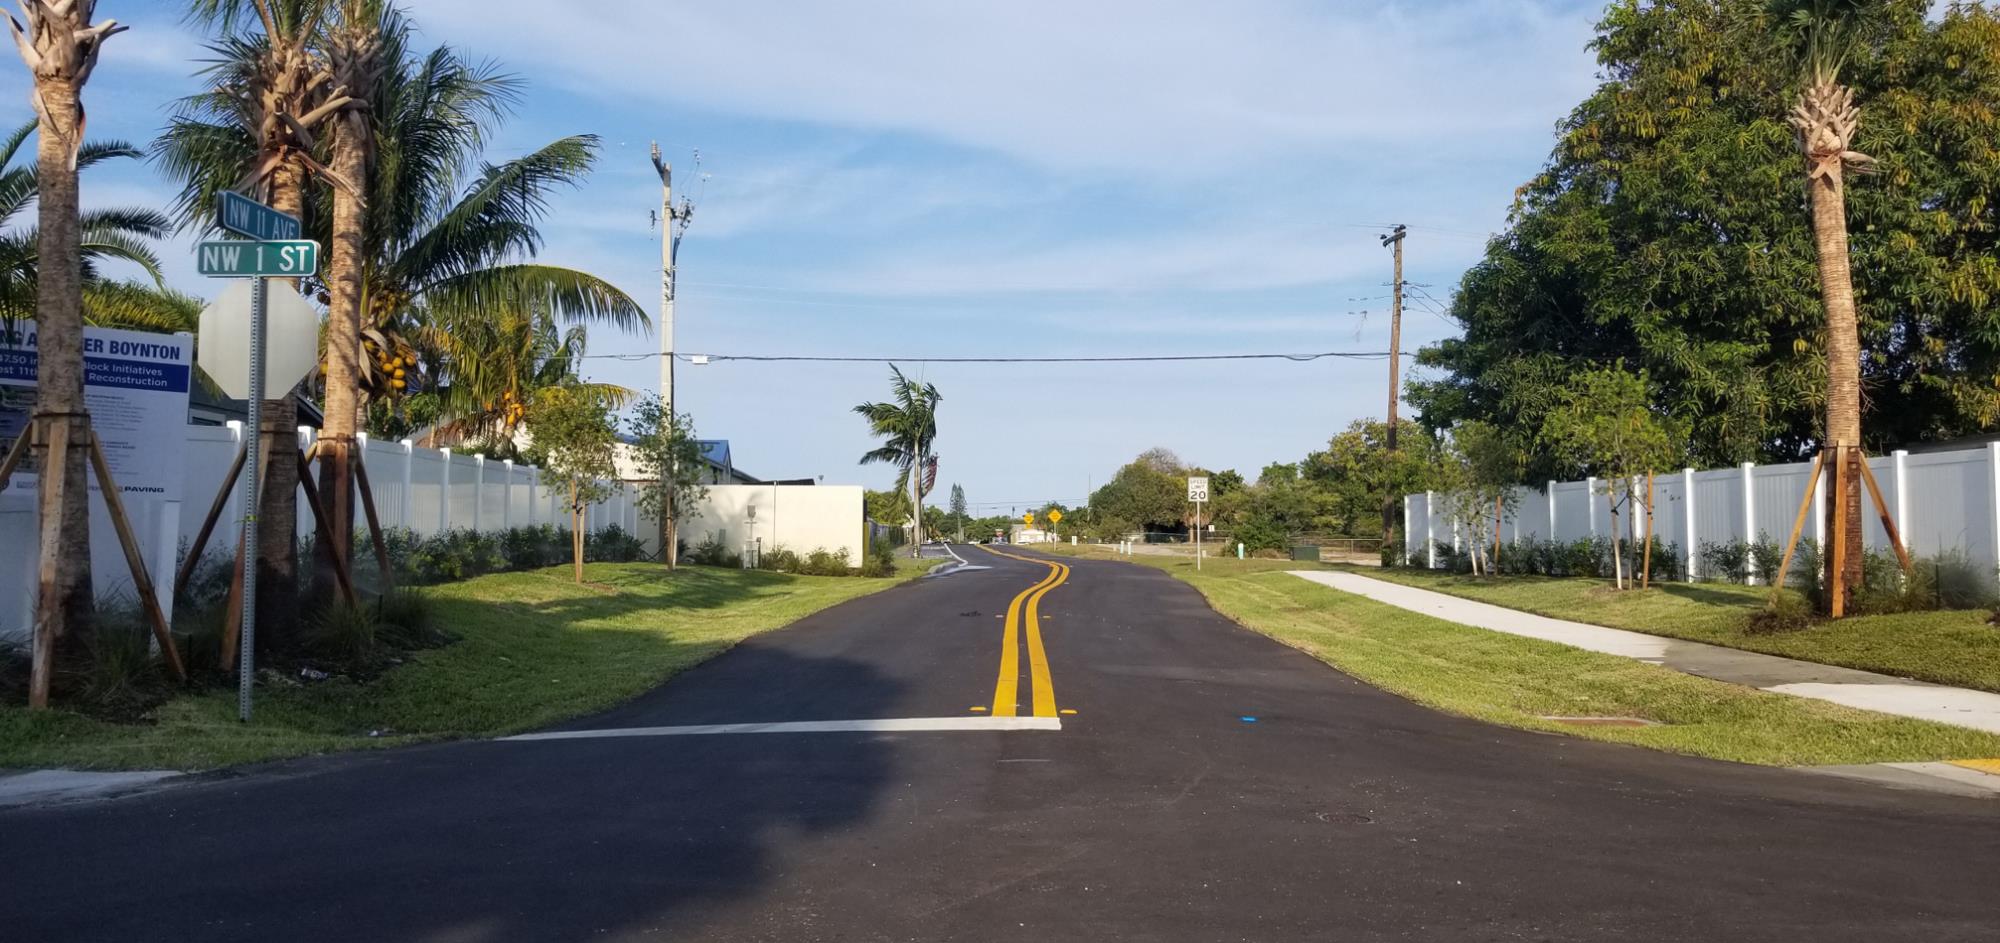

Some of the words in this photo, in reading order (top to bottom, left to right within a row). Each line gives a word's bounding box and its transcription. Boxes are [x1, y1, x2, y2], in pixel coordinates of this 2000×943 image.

[229, 198, 250, 230] NW
[256, 209, 266, 237] 11
[272, 217, 296, 240] AVE
[203, 245, 241, 272] NW
[256, 245, 263, 272] 1
[279, 245, 310, 272] ST
[109, 340, 180, 360] BOYNTON
[112, 364, 163, 376] Initiatives
[88, 372, 168, 387] Reconstruction
[1190, 490, 1206, 500] 20
